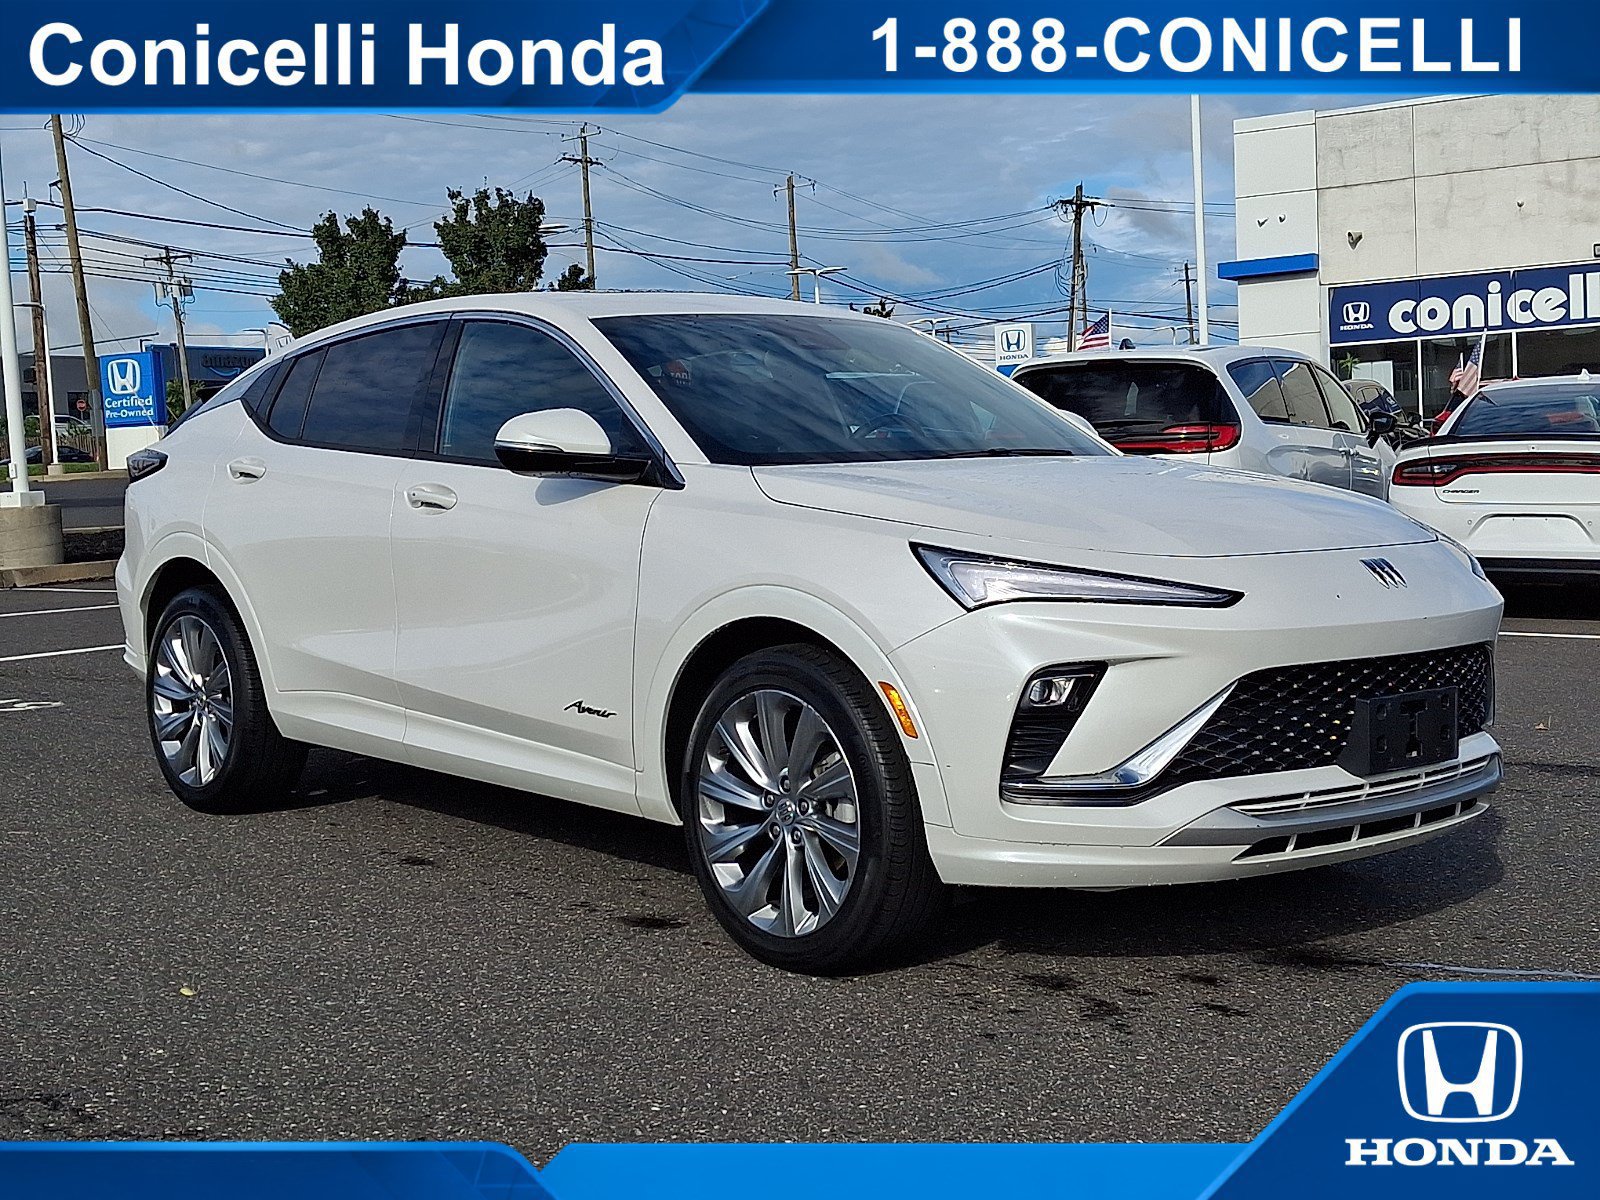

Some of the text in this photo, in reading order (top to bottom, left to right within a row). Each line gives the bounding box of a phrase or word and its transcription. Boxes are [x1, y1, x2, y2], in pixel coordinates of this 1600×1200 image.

[1339, 323, 1374, 331] HONDA
[104, 395, 153, 408] Certified
[105, 408, 154, 418] Pre-Owned
